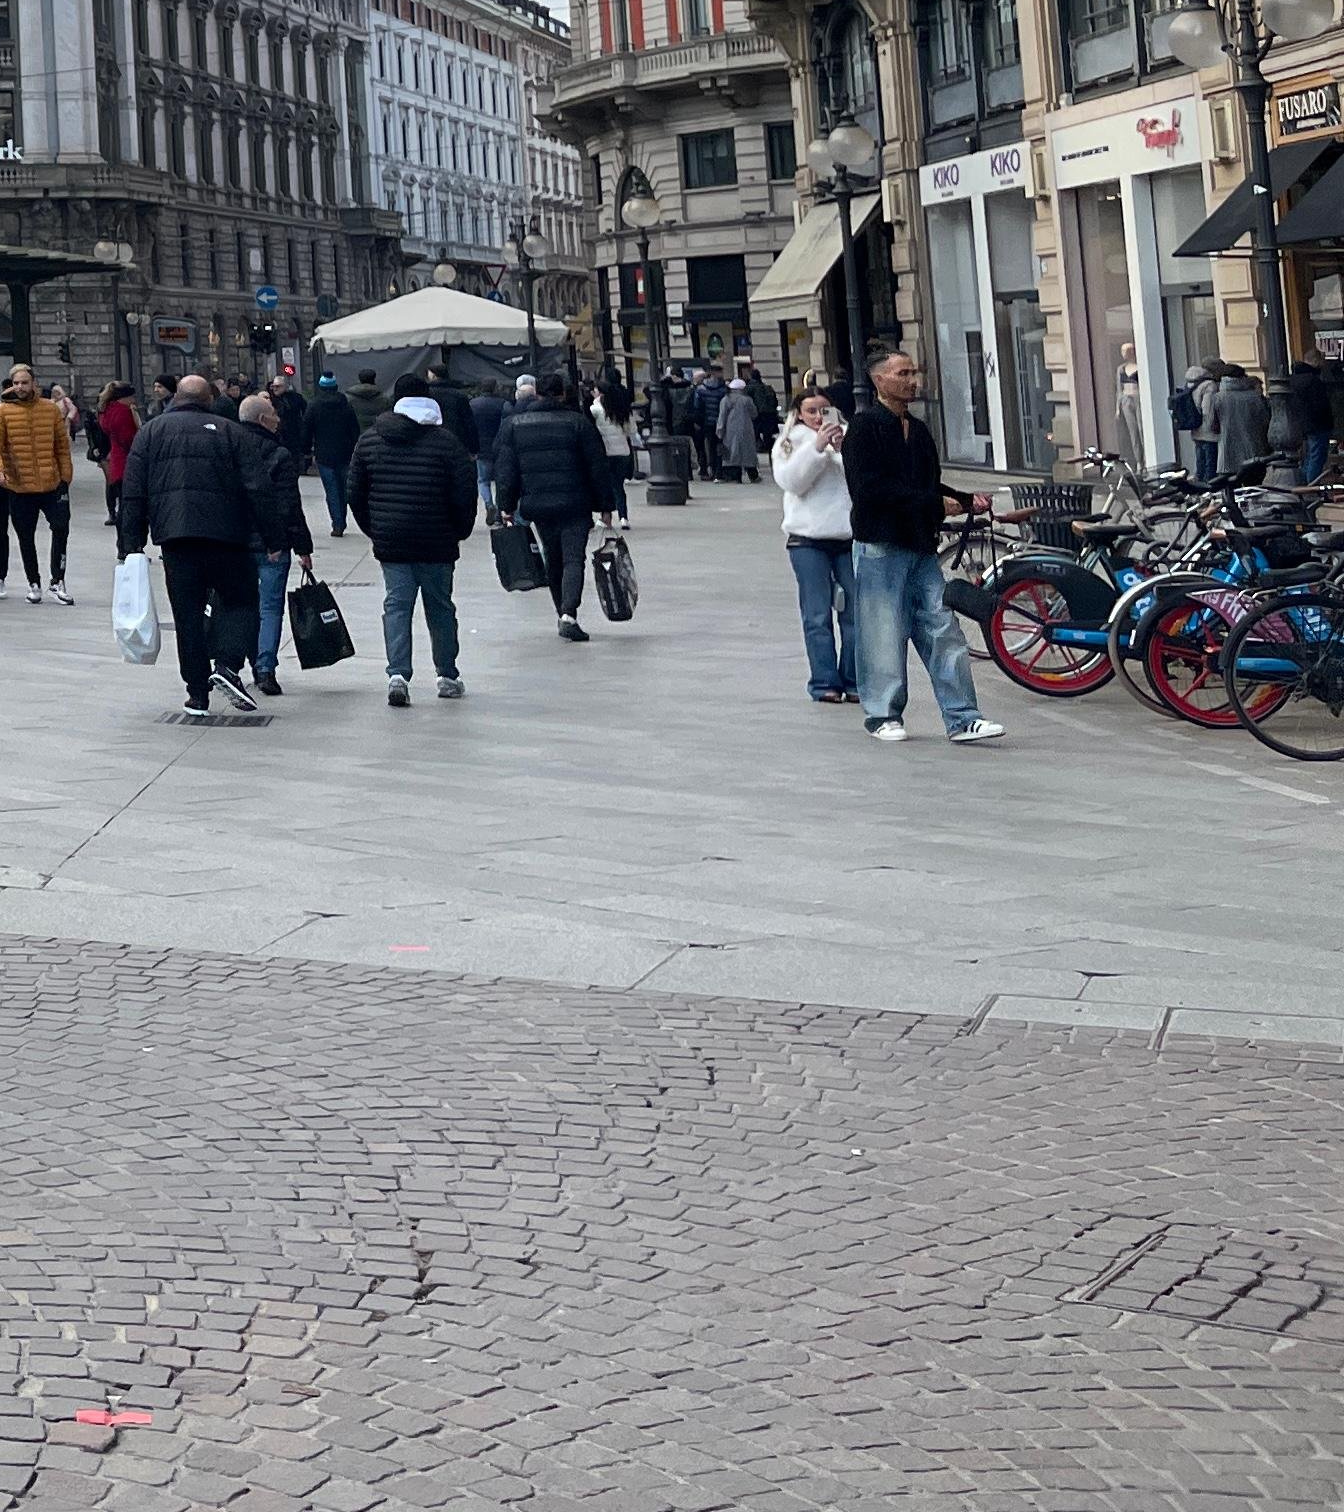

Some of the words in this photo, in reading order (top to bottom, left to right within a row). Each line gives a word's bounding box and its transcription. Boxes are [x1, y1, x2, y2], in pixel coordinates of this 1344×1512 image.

[1277, 89, 1328, 122] FUSARO
[933, 163, 960, 190] KIKO
[990, 148, 1021, 177] KIKO
